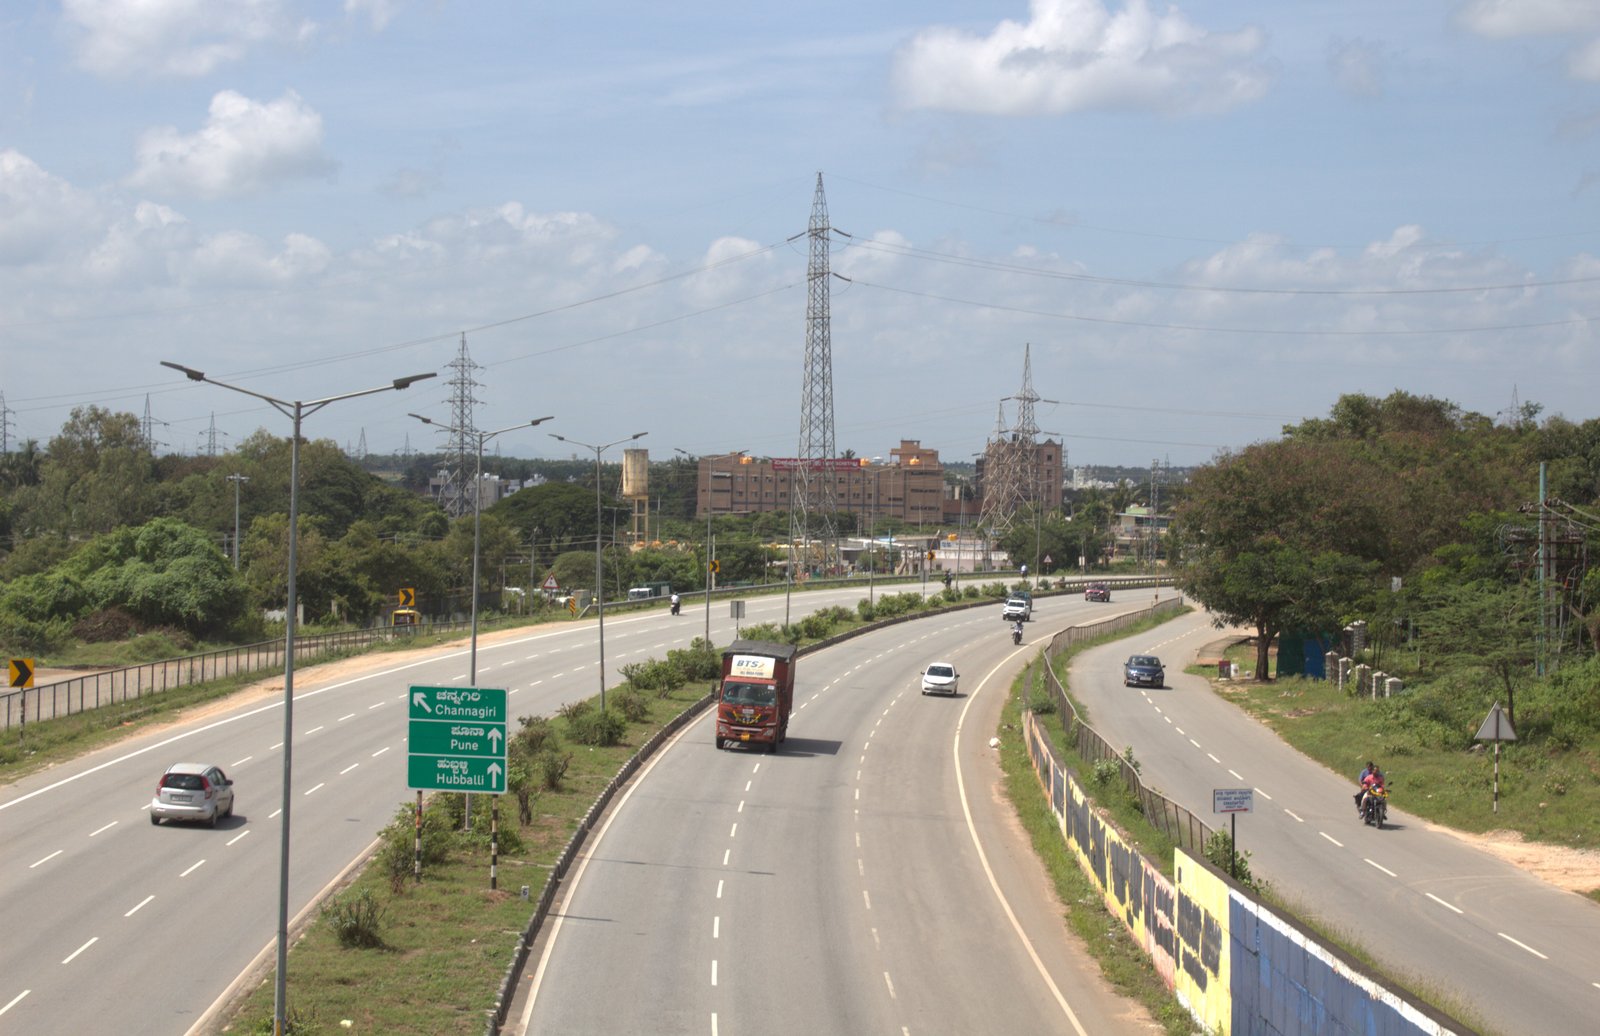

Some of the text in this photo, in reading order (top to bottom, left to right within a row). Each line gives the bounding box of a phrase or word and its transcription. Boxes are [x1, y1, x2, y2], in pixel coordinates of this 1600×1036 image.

[737, 660, 759, 668] BTS
[436, 690, 481, 704] ಚನ್ನಗಿರಿ
[435, 704, 496, 718] Channagiri
[451, 739, 479, 751] Pune
[436, 774, 484, 785] Hubballi
